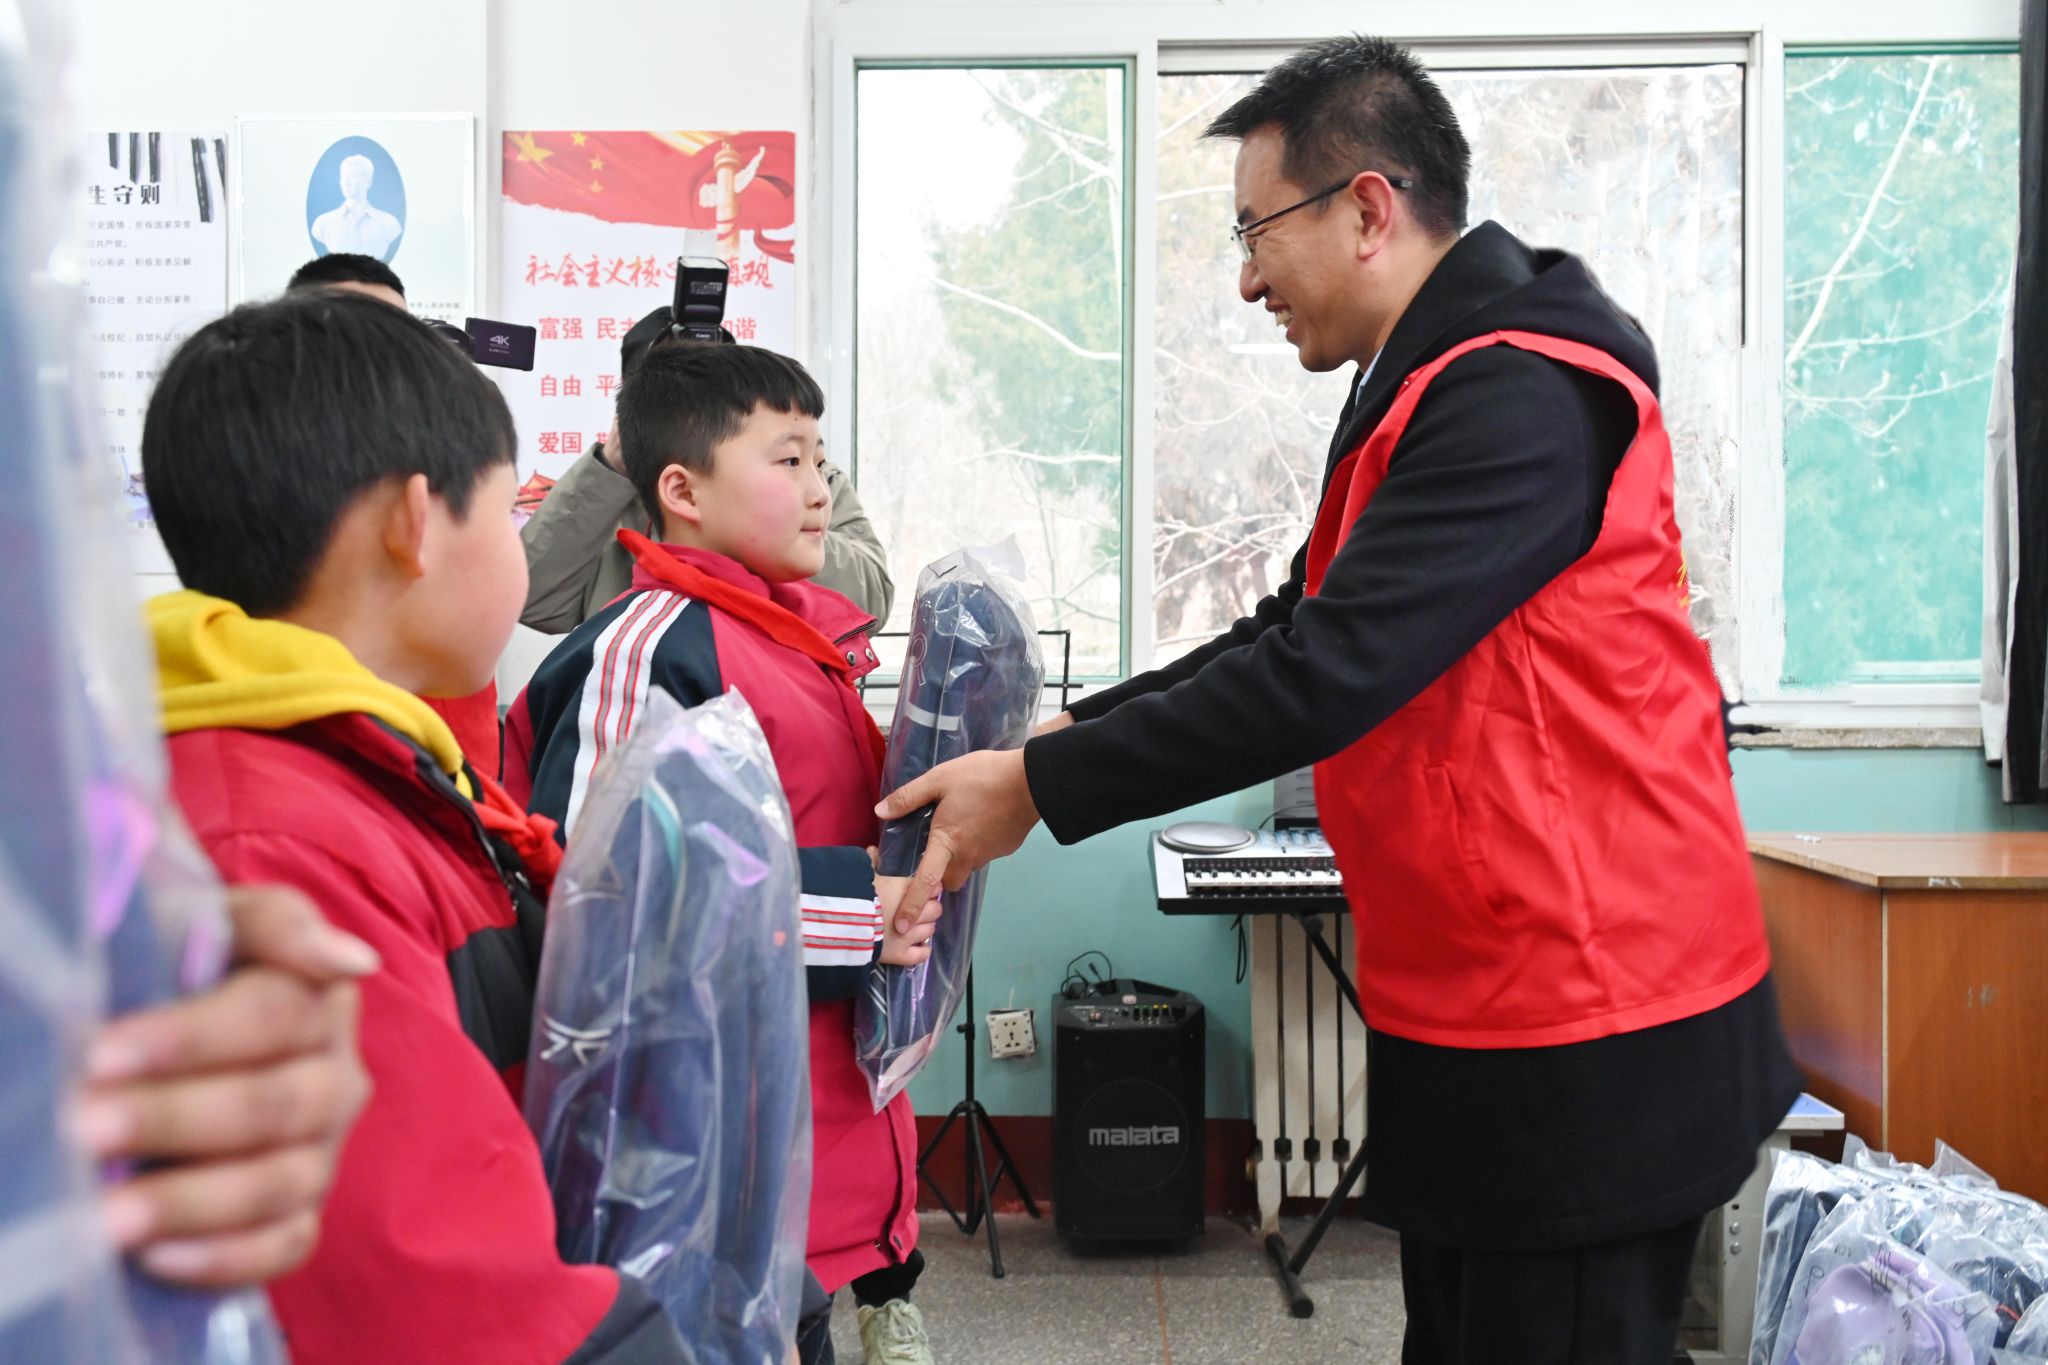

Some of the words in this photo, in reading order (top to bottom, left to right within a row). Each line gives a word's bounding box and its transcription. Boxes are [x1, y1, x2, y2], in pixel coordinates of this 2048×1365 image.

[538, 317, 583, 340] 富强
[490, 335, 510, 346] 4K
[540, 374, 582, 397] 自由
[538, 431, 582, 455] 爱国
[1089, 1125, 1180, 1146] malata
